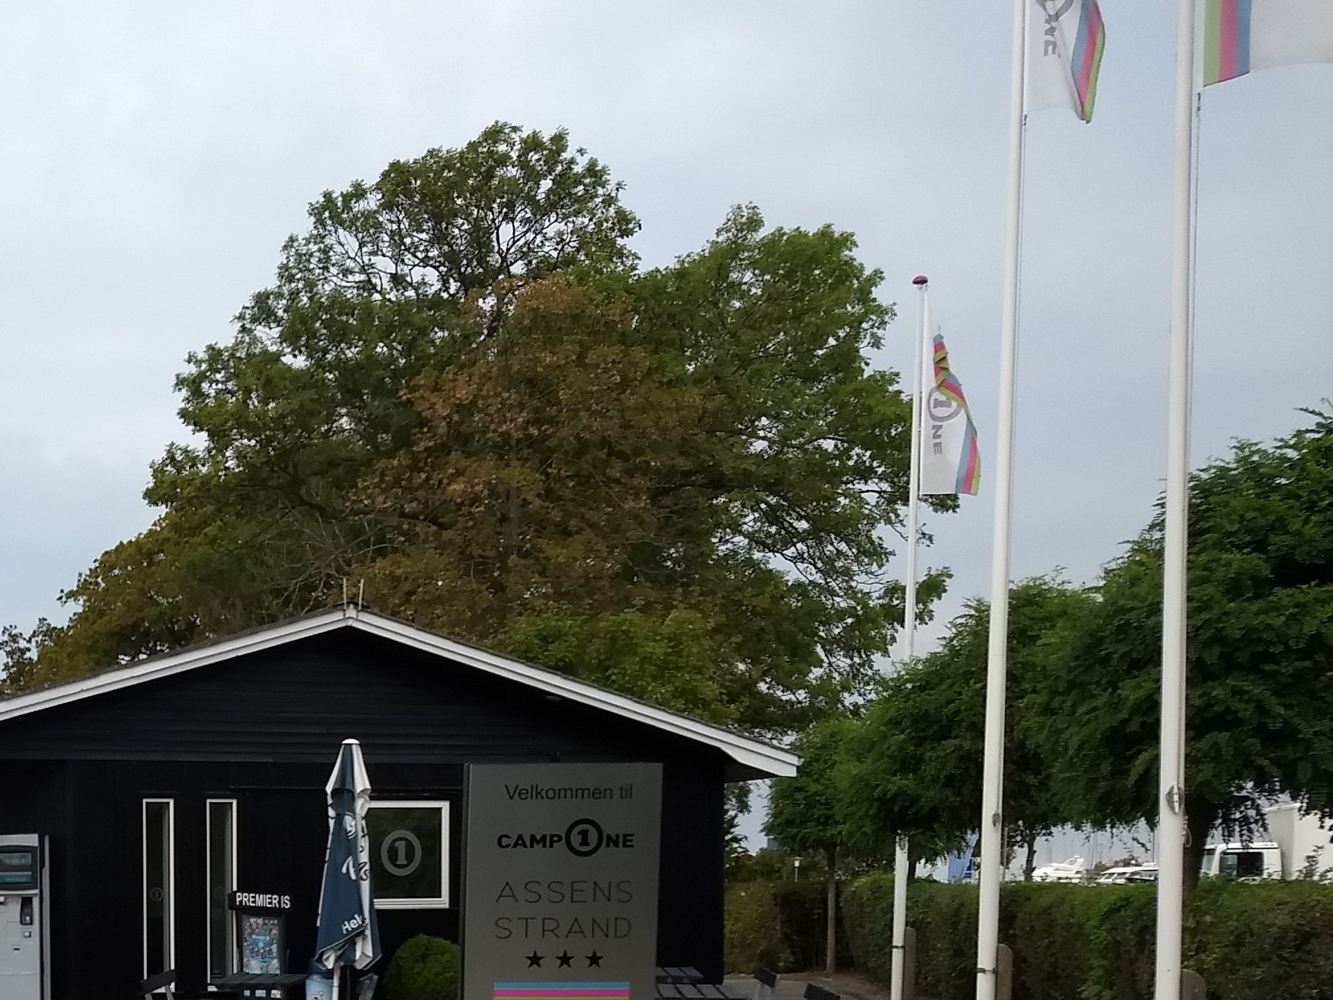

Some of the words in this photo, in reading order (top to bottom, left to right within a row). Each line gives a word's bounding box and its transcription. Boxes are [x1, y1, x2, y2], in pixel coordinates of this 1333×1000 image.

[504, 784, 614, 801] Velkommen
[619, 784, 633, 800] til
[235, 892, 280, 909] PREMIER
[280, 895, 291, 909] IS
[495, 880, 634, 904] ASSENS
[494, 916, 632, 939] STRAND
